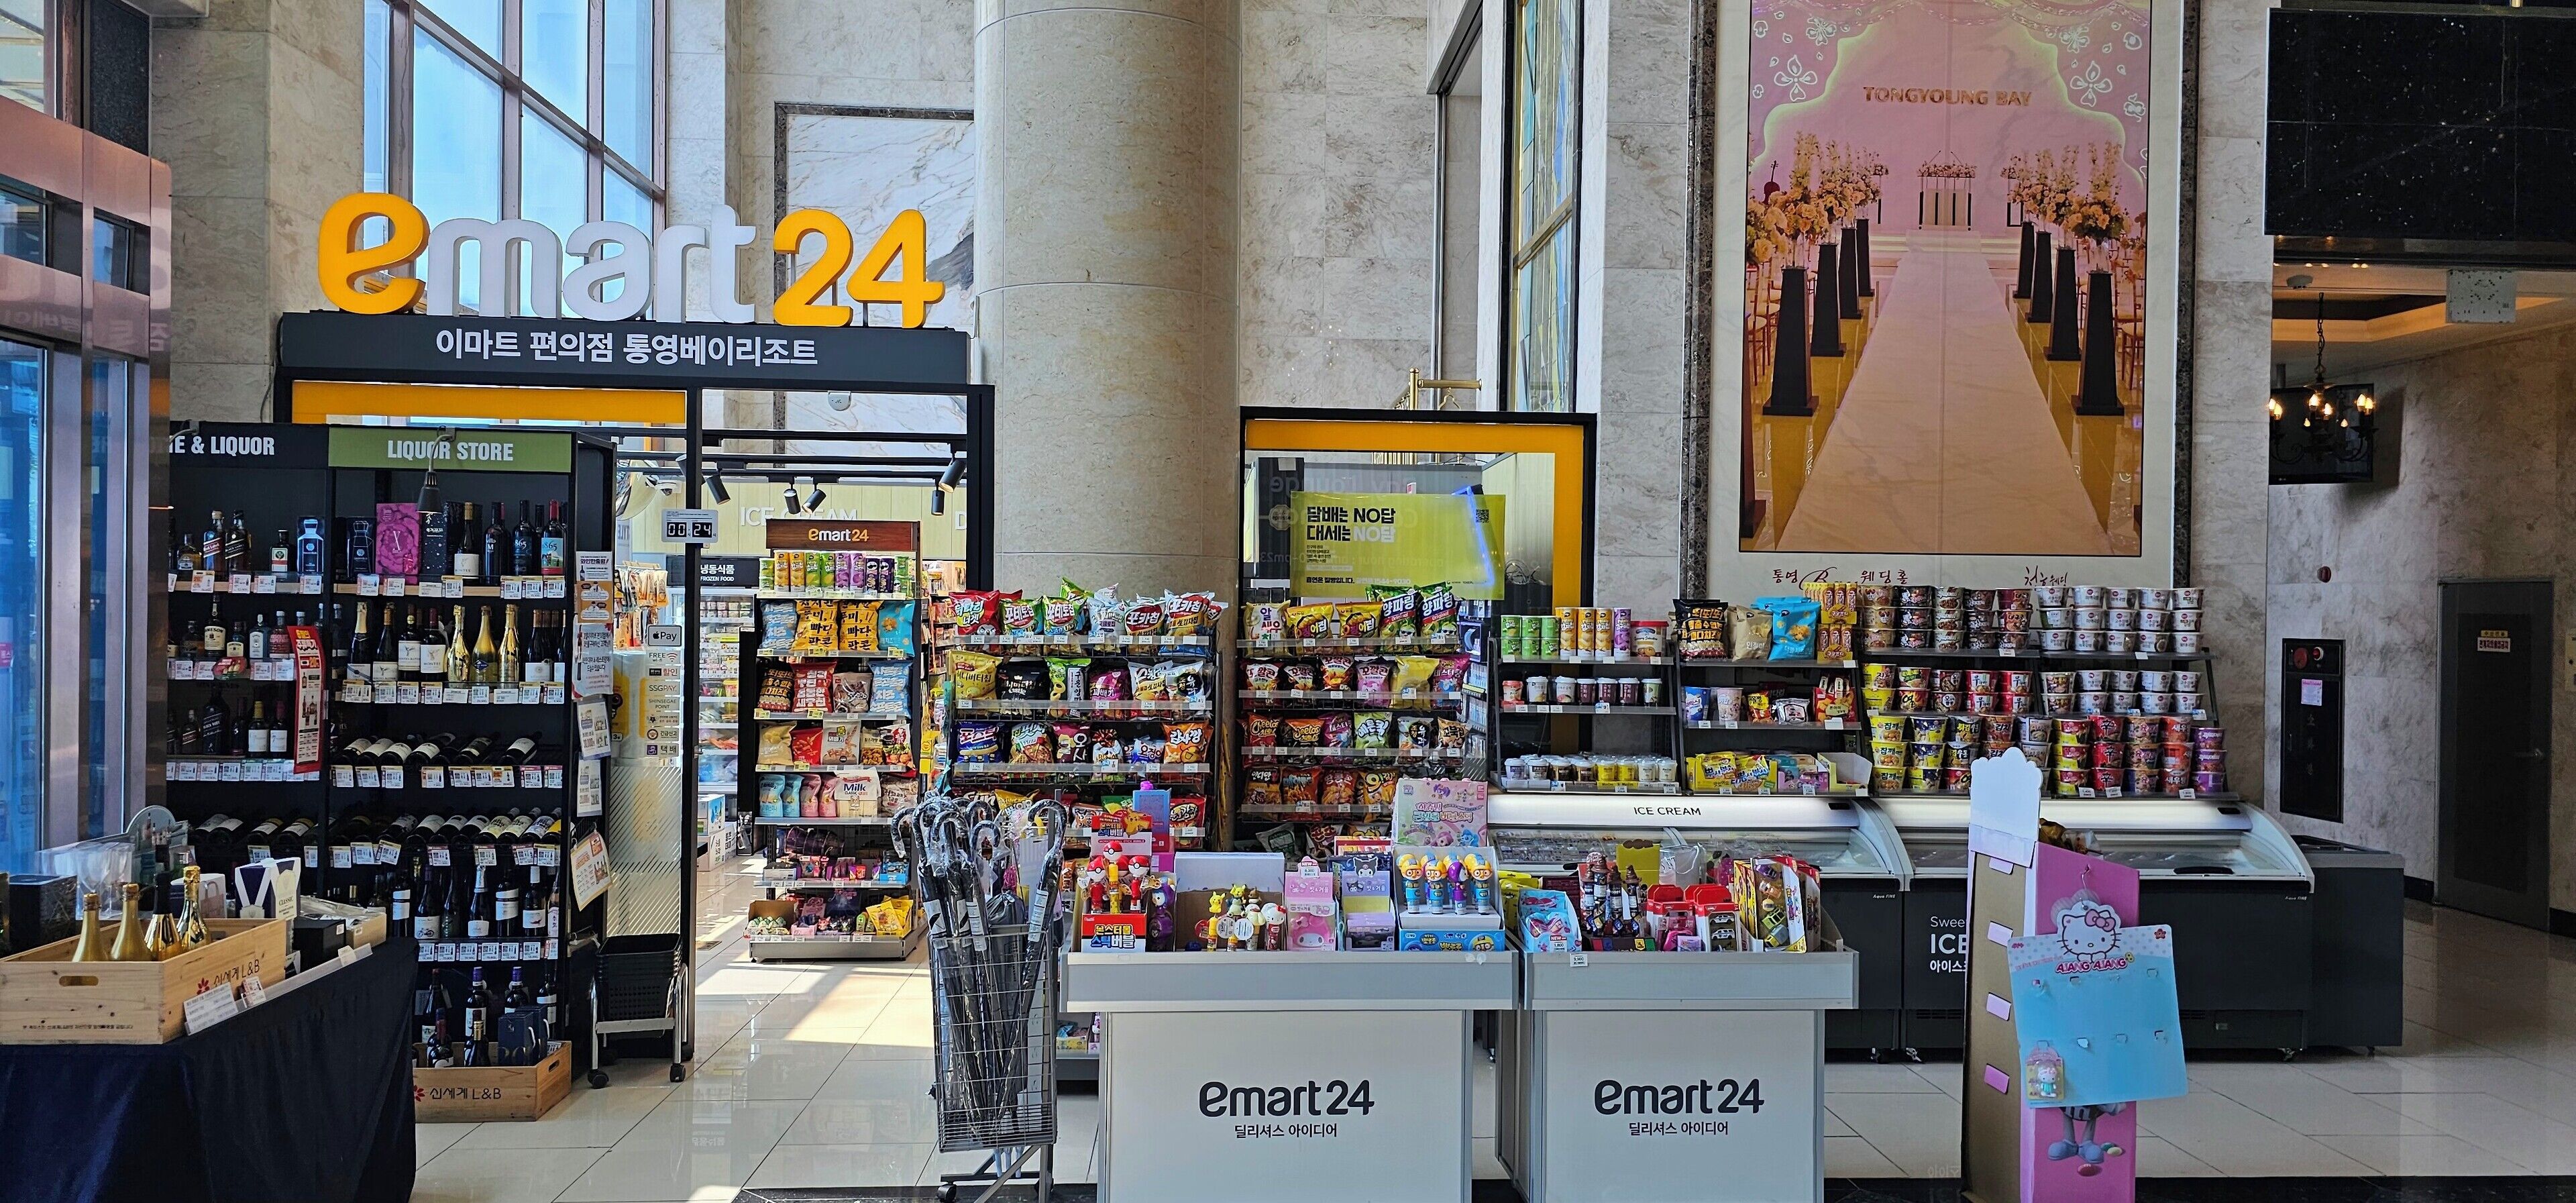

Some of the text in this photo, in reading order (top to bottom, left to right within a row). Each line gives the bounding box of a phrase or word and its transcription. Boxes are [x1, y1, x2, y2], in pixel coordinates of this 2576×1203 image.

[1863, 87, 2032, 107] TONGYOUNG BAY
[317, 192, 945, 329] emart24
[435, 329, 818, 366] 이마트 편의점 통영베이리조트
[192, 436, 274, 456] & LIQUOR
[387, 440, 514, 462] LIQUOR STORE
[1307, 507, 1348, 523] 담배는
[1354, 507, 1396, 524] NO답
[668, 523, 711, 535] 00 24
[808, 528, 869, 542] emart24
[1307, 525, 1351, 541] 대세는
[700, 564, 735, 576] 냉동식품
[1773, 569, 1798, 584] 통영
[1169, 597, 1202, 613] 포카칩
[1383, 595, 1415, 617] 양파링
[1421, 592, 1453, 617] 양파링
[1126, 611, 1161, 625] 포카칩
[660, 631, 677, 641] Pay
[843, 783, 866, 792] Milk
[1633, 807, 1701, 816] ICE CREAM
[1930, 915, 1967, 928] Swee
[1094, 924, 1132, 936] 몬스터볼
[1090, 935, 1135, 950] 스틱버블
[241, 959, 260, 979] L&B
[1930, 960, 1967, 974] 아이스
[430, 1087, 502, 1100] 신세계 L&B
[1199, 1079, 1375, 1117] emart24
[1594, 1077, 1765, 1116] emart24
[1234, 1123, 1339, 1139] 딜리셔스 아이디어
[1629, 1120, 1729, 1137] 딜리셔스 아이디어
